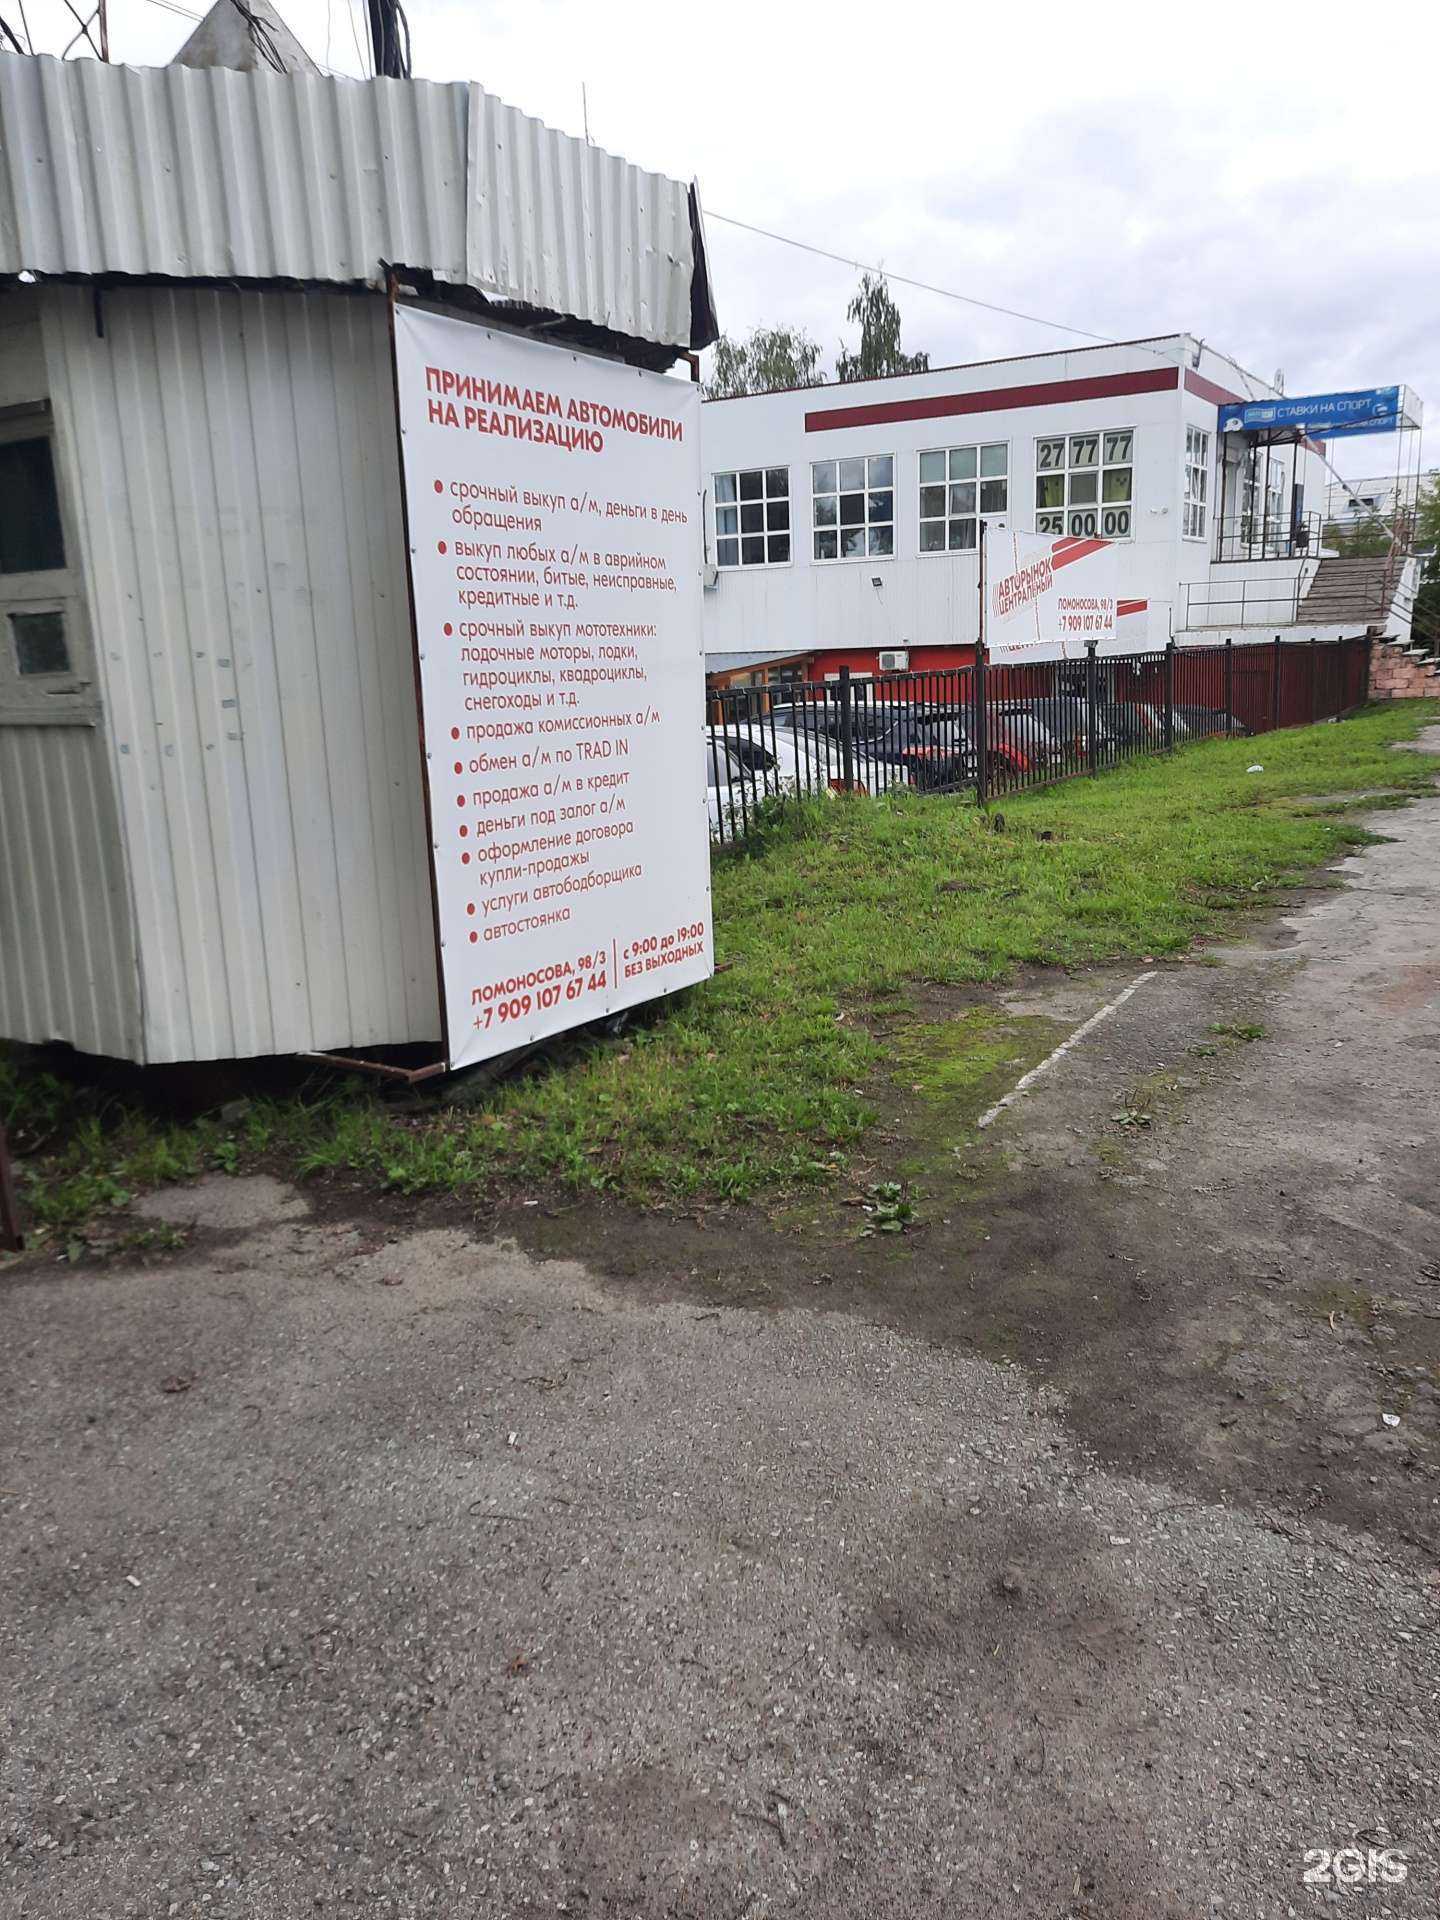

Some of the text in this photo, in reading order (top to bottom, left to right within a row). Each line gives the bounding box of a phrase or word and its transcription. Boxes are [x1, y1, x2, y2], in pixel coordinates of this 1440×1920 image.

[425, 367, 683, 442] ПРИНИМАЕМ АВТОМОБИЛИ
[1277, 404, 1319, 417] СТАВКИ
[1321, 402, 1335, 412] НА
[1337, 399, 1372, 411] СПОРТ
[428, 399, 604, 453] НА РЕАЛИЗАЦИЮ
[1040, 436, 1131, 468] 27 77 77
[450, 480, 688, 525] срочный выкуп а/м, деньги в день
[452, 506, 543, 531] обращения
[1040, 511, 1129, 536] 25 00 00
[455, 541, 666, 571] выкуп любых а/м в аврийном
[456, 565, 677, 592] состоянии, битые, неисправные,
[998, 556, 1052, 596] АВТОРЫНОК
[459, 589, 578, 609] кредитные и т.д.
[998, 575, 1053, 615] ЦЕНТРАЛЬНЫЙ
[1058, 598, 1099, 611] ЛОМОНОСОВА,
[459, 620, 657, 642] срочный выкуп мототехники:
[1058, 615, 1113, 631] +7 909 107 67 44
[461, 646, 638, 664] лодочные моторы, лодки,
[463, 664, 648, 688] гидроциклы, квадроциклы,
[464, 692, 580, 711] снегоходы и т.д.
[466, 705, 660, 743] продажа комиссионных а/м
[469, 738, 629, 774] обмен а/м по TRAD IN
[472, 770, 630, 810] продажа а/м в кредит
[476, 793, 626, 838] деньги под залог а/м
[478, 820, 634, 862] оформление договора
[480, 852, 590, 887] купли-продажы
[481, 864, 642, 916] услуги автободборщика
[483, 907, 571, 941] автостоянка
[623, 922, 704, 960] с 9:00 до 19:00
[624, 941, 704, 978] БЕЗ ВЫХОДНЫХ
[471, 952, 606, 1006] ЛОМОНОСОВА, 98/3
[472, 970, 607, 1030] +7 909 107 67 44
